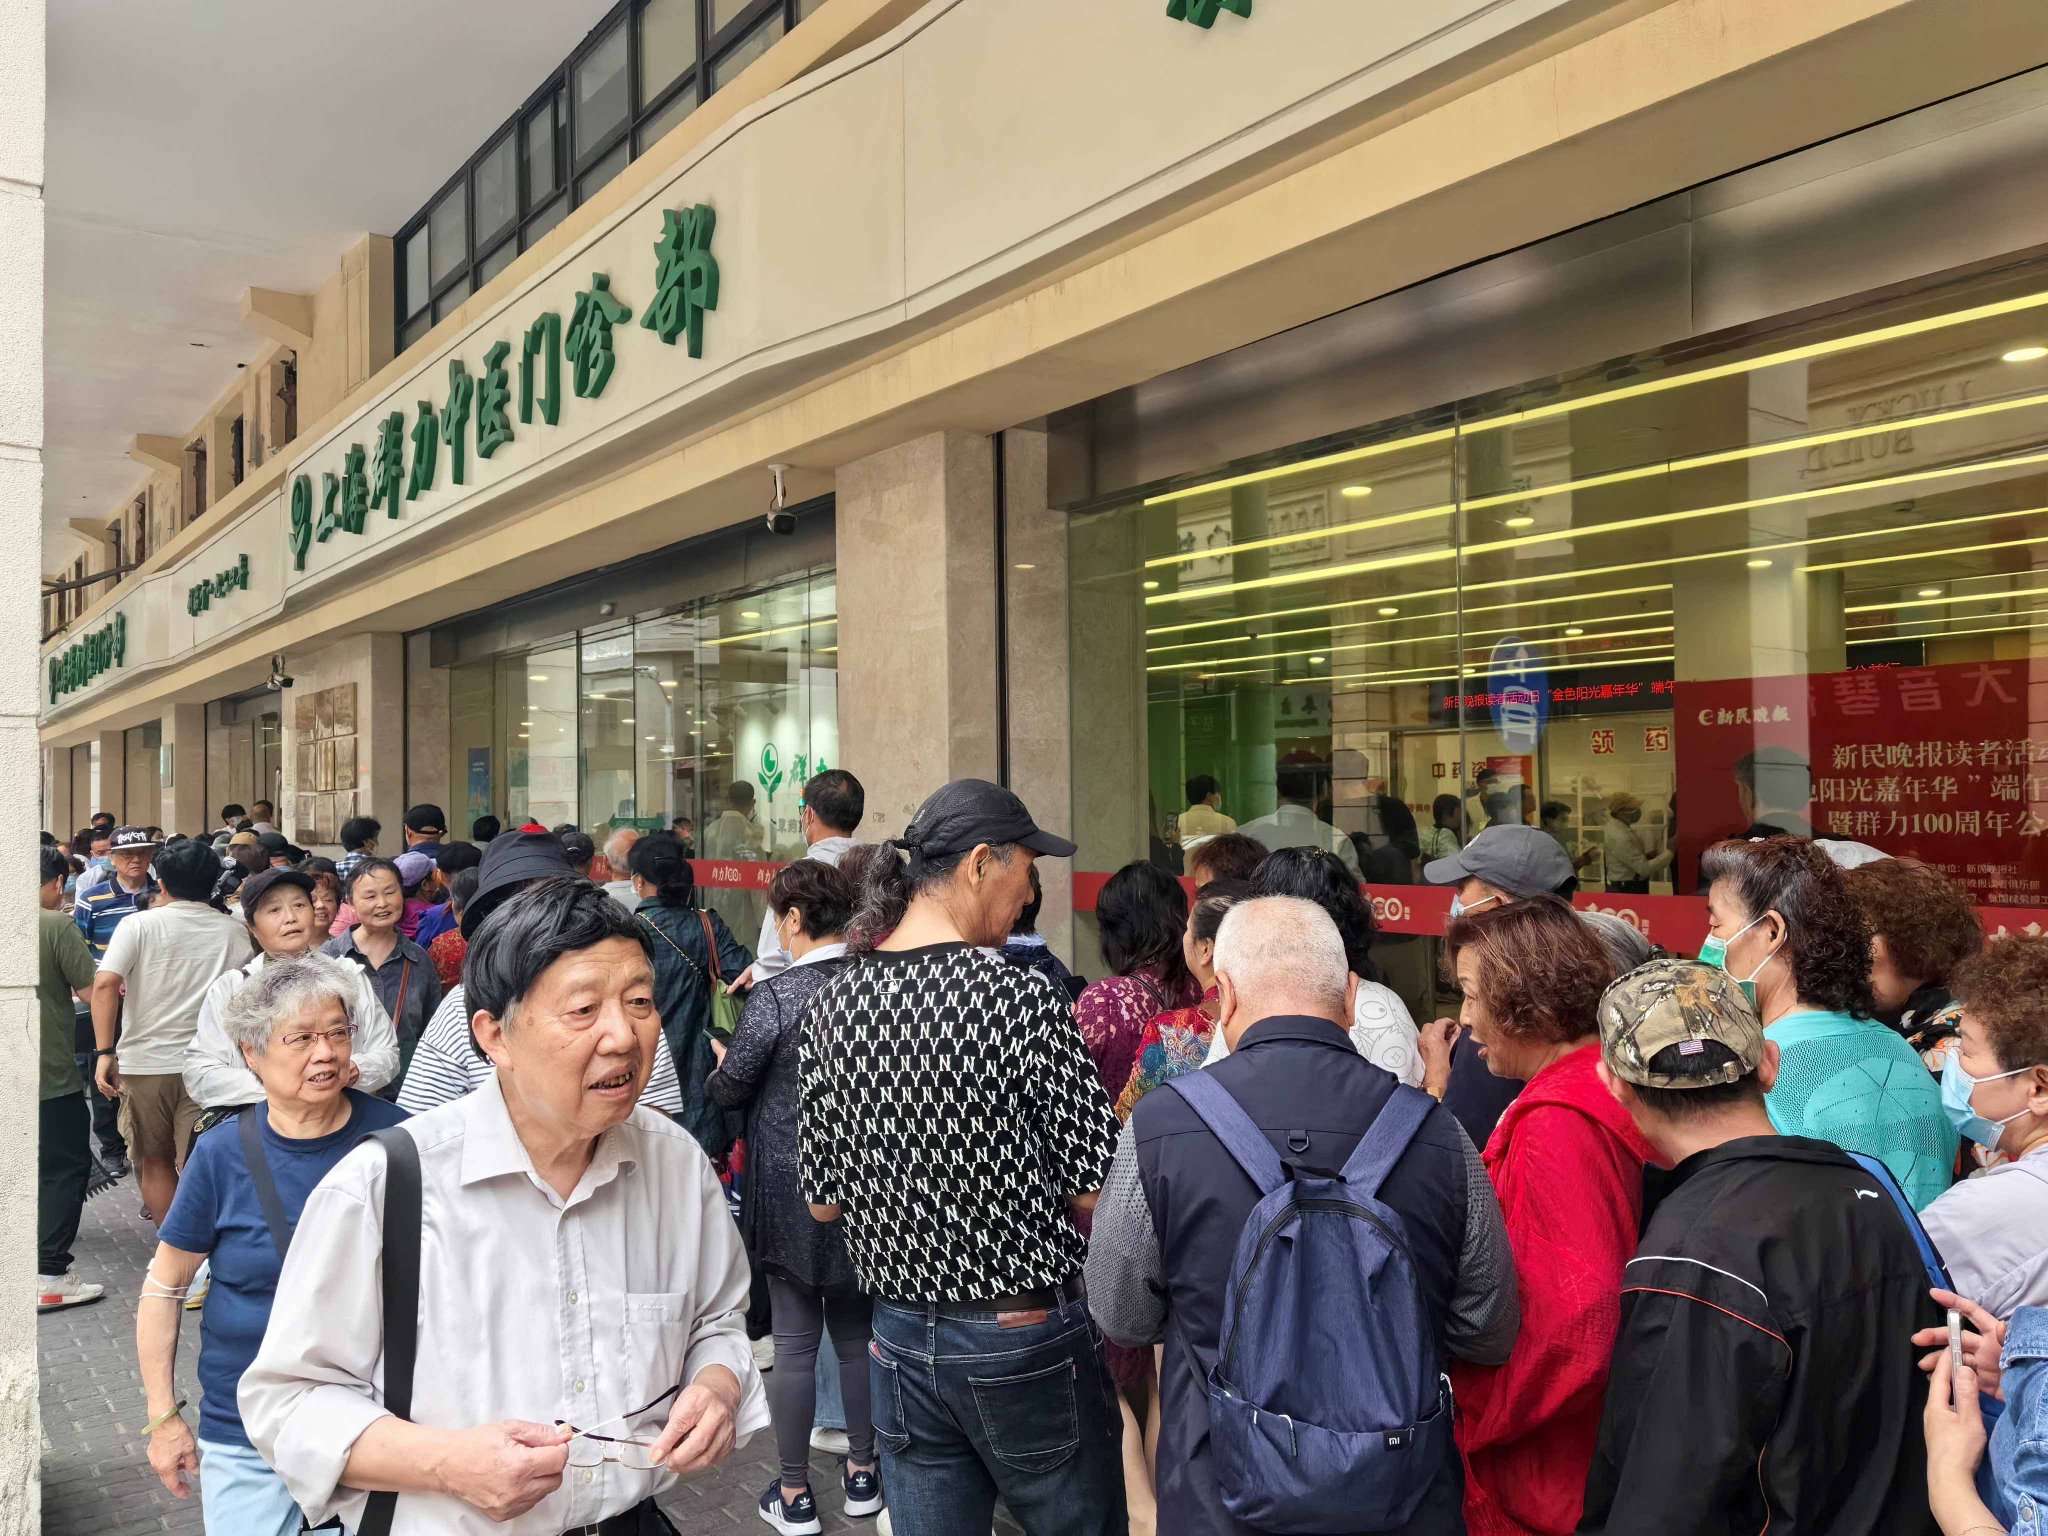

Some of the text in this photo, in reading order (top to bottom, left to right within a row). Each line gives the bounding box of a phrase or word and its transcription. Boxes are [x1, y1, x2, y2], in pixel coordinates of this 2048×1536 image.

[316, 203, 720, 543] 上海群力中医门诊部
[1591, 727, 1669, 754] 领药
